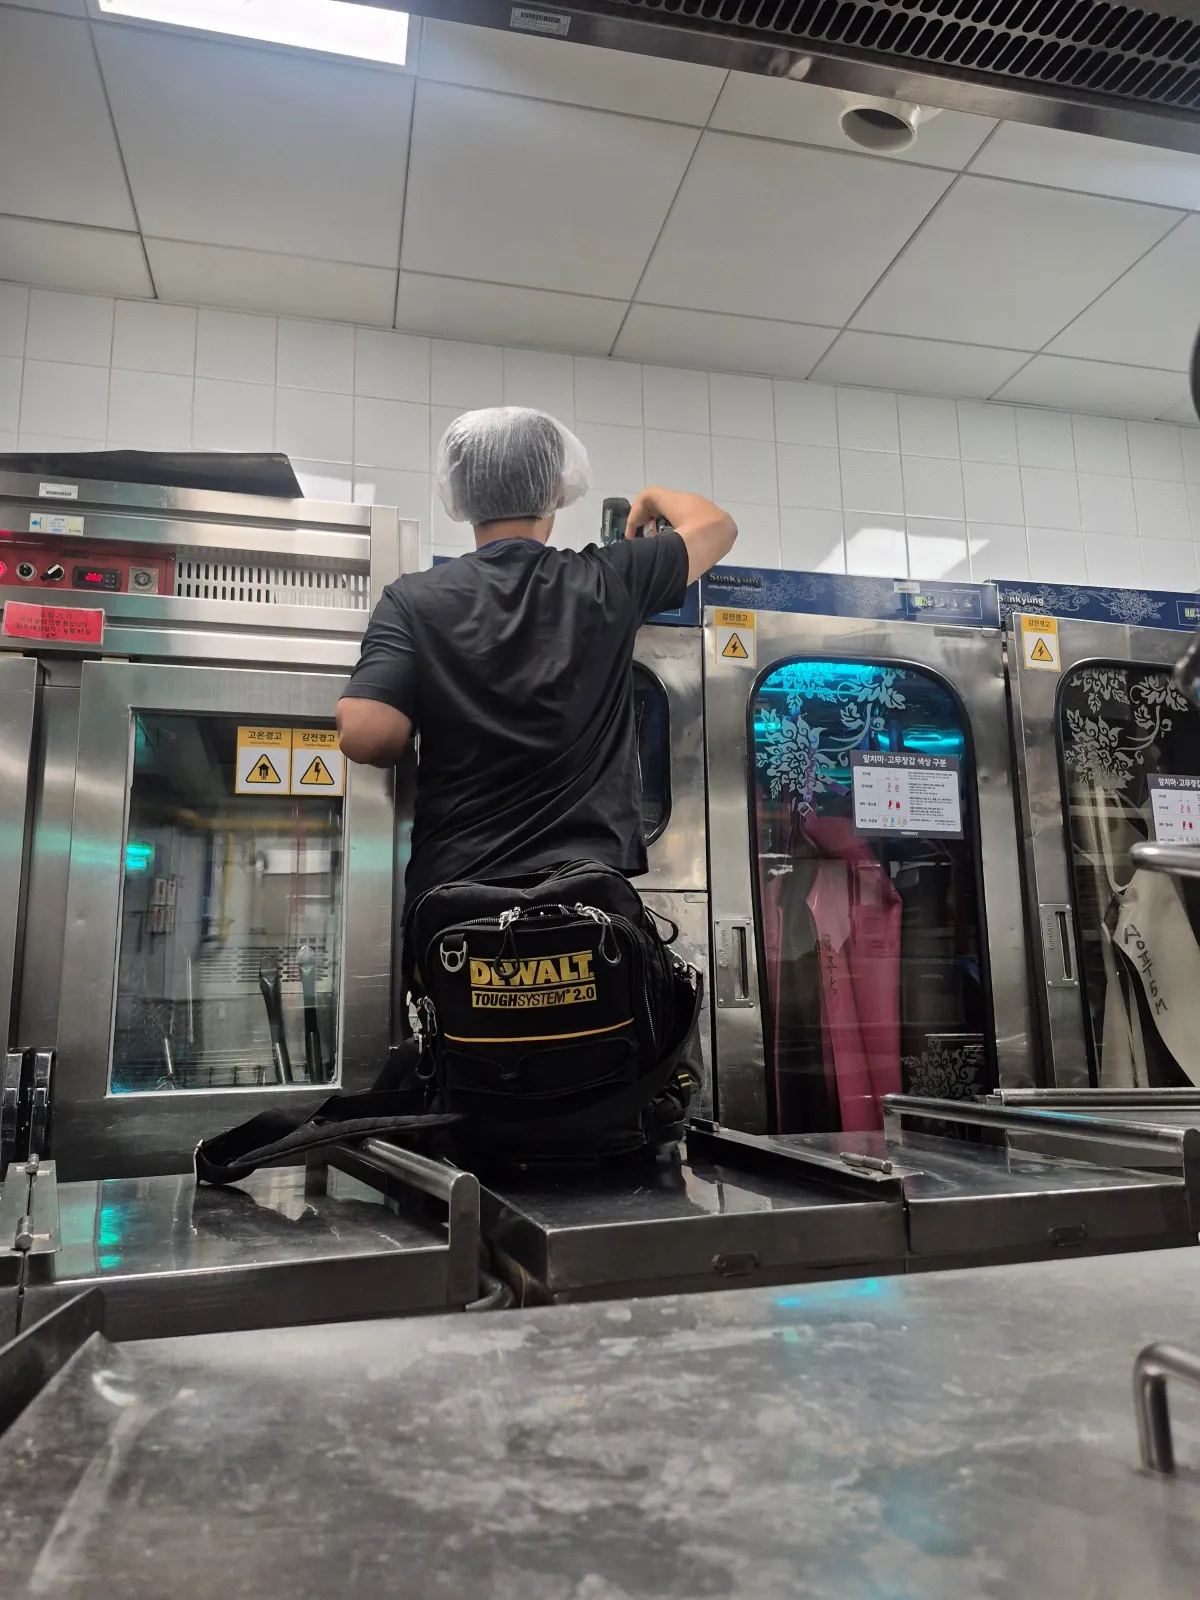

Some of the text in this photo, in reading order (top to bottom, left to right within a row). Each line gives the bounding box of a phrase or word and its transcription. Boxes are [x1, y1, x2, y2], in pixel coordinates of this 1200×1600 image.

[722, 612, 748, 622] 감전경고
[1028, 619, 1051, 628] 감전경고
[248, 730, 282, 740] 고온경고
[302, 733, 335, 743] 감전경고
[917, 757, 931, 767] 색상
[933, 758, 947, 768] 구분
[572, 986, 595, 1001] 2.0
